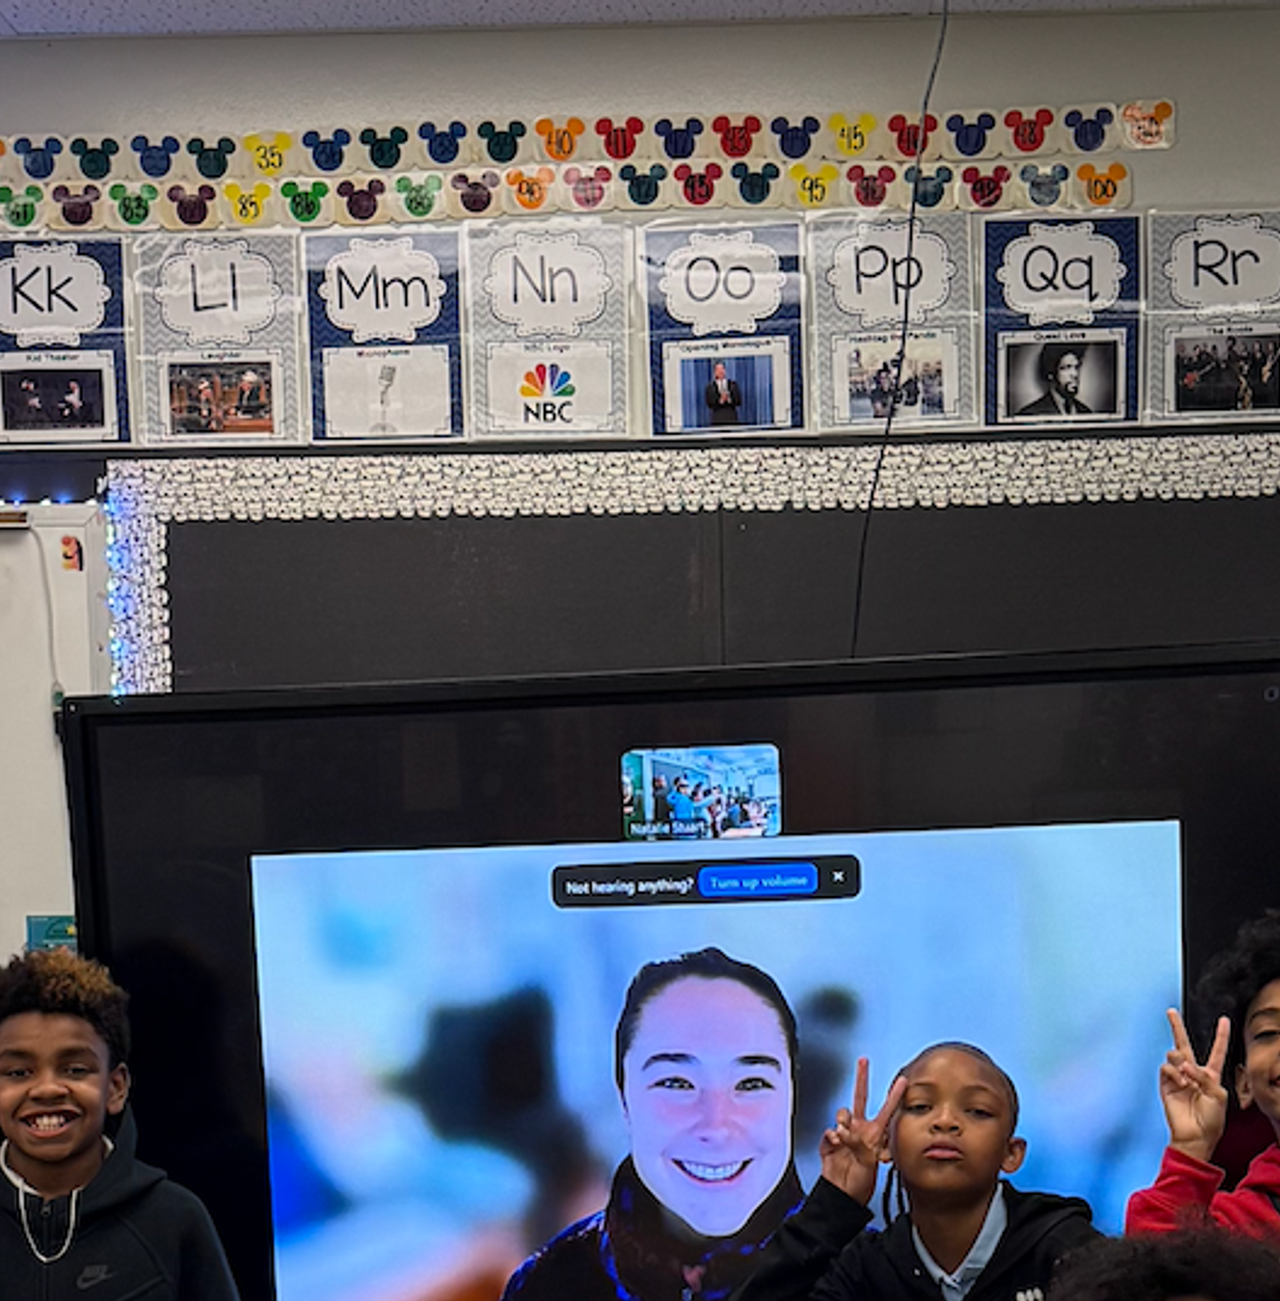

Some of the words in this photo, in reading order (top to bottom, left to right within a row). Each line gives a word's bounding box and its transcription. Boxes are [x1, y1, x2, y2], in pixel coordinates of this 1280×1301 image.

[547, 128, 573, 156] 40
[841, 128, 865, 153] 45
[256, 147, 282, 172] 35
[519, 182, 543, 206] 90
[803, 177, 827, 203] 95
[1086, 177, 1117, 202] 100
[122, 197, 147, 224] 83
[237, 194, 261, 219] 85
[292, 194, 318, 219] 86
[853, 245, 923, 305] Pp
[1021, 245, 1099, 302] Qq
[1192, 240, 1260, 288] Rr
[10, 266, 79, 315] Kk
[190, 263, 238, 312] Ll
[336, 265, 430, 312] Mm
[510, 254, 579, 304] Nn
[683, 255, 756, 302] Oo
[680, 344, 719, 353] Opening
[849, 335, 888, 344] Hashtag
[201, 351, 243, 361] Laughter
[522, 400, 574, 425] NBC
[630, 821, 670, 836] Natalie
[671, 820, 706, 834] Stuart
[565, 882, 590, 894] Not
[591, 881, 636, 896] hearing
[637, 879, 694, 895] anything?
[710, 876, 740, 888] Turn
[742, 878, 760, 890] up
[761, 874, 808, 887] volume
